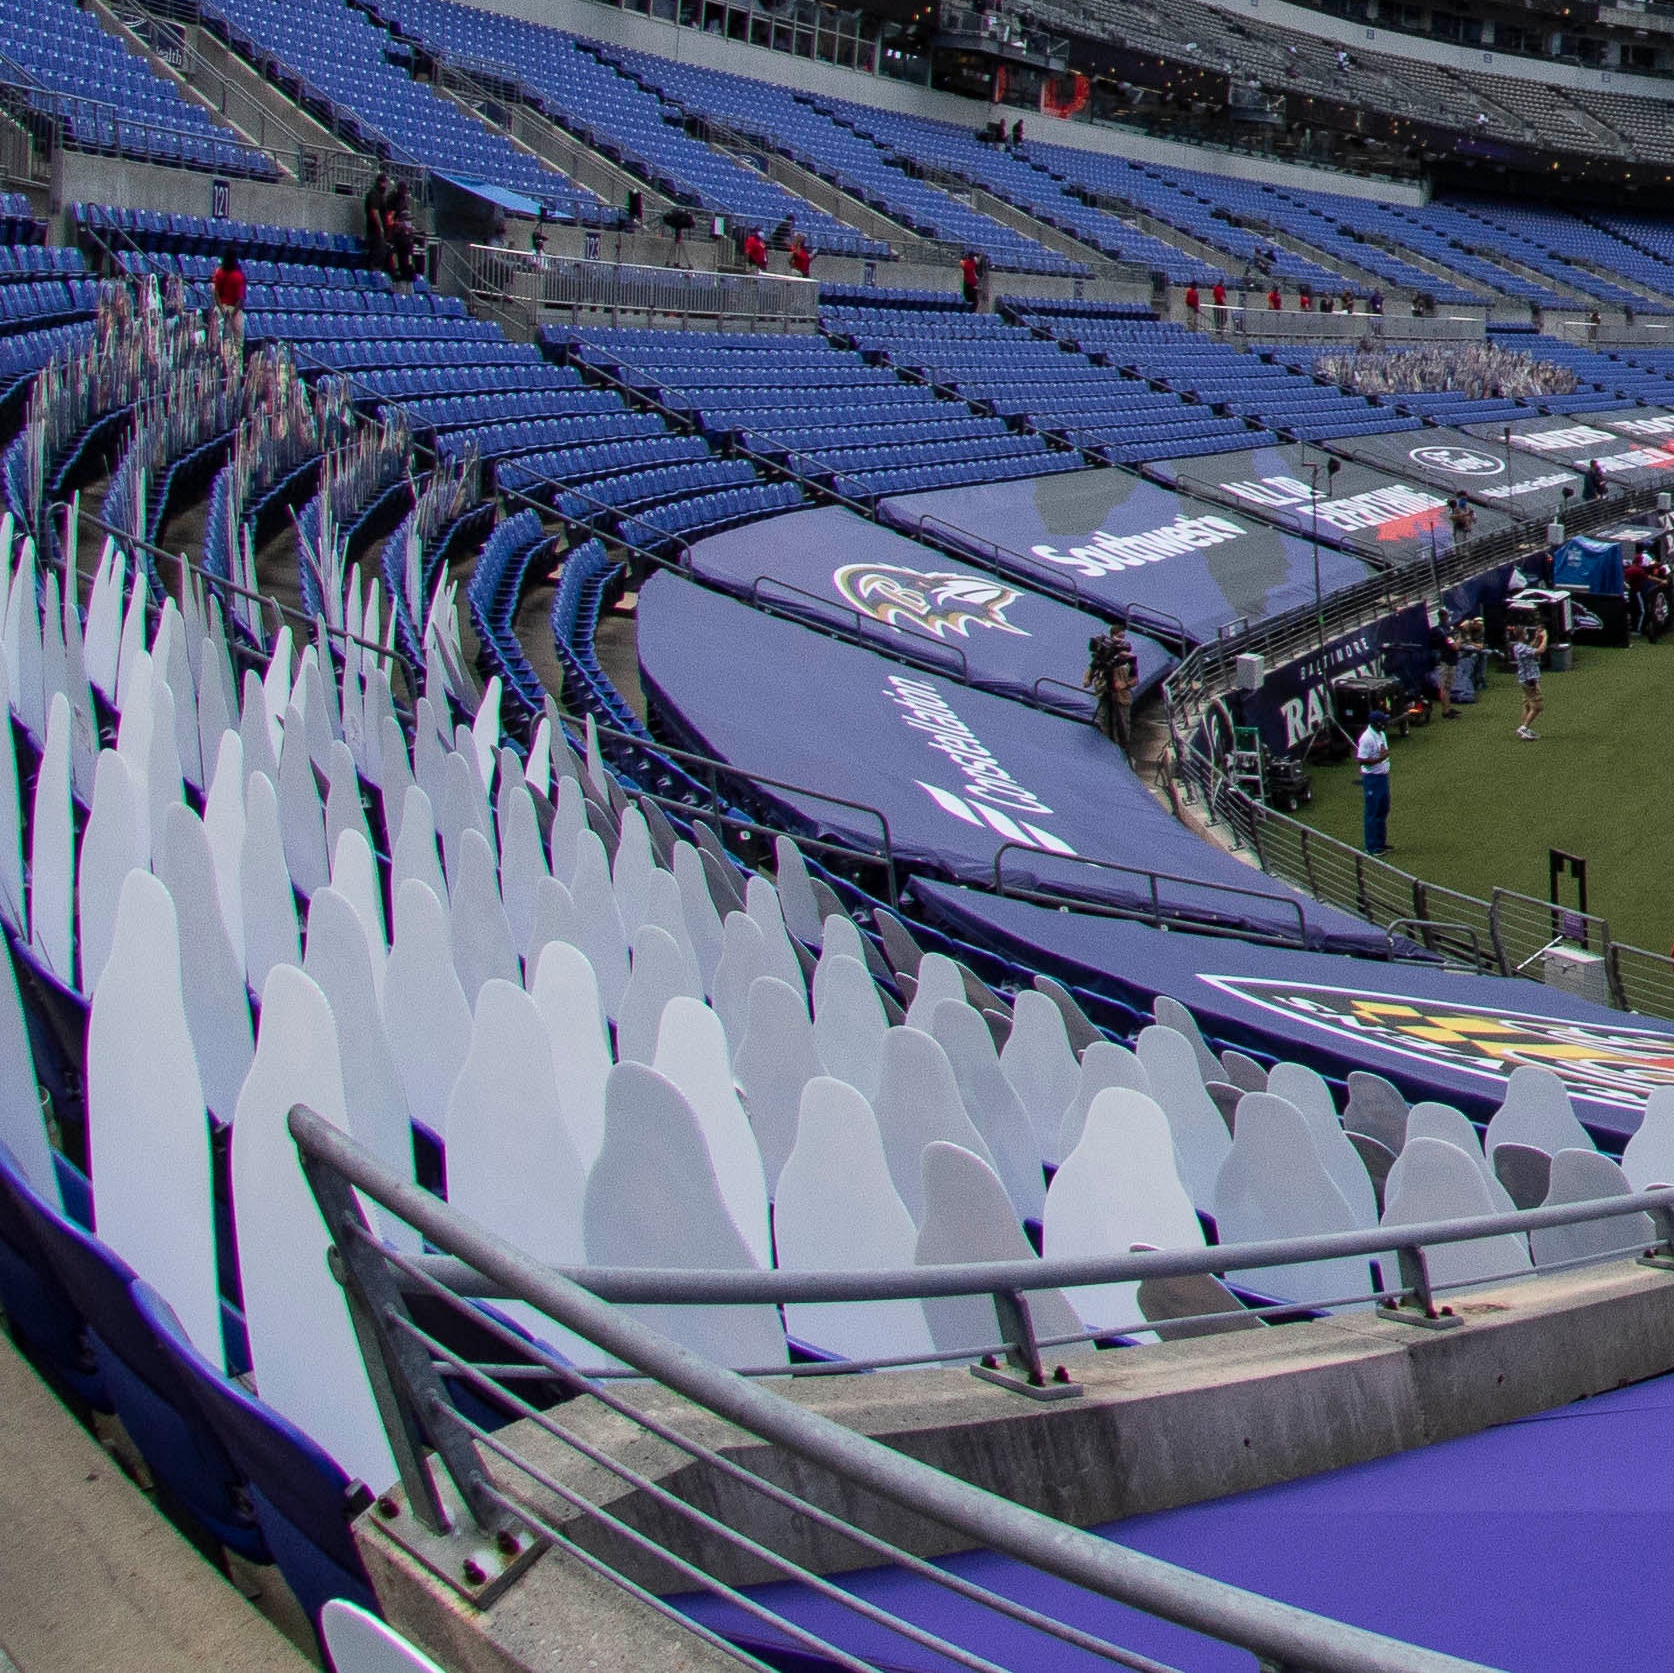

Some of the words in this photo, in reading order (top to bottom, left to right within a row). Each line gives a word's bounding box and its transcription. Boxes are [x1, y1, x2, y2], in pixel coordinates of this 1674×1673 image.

[1420, 449, 1496, 473] Ford
[1299, 636, 1370, 681] BALTIMORE
[881, 675, 1056, 814] Constellation
